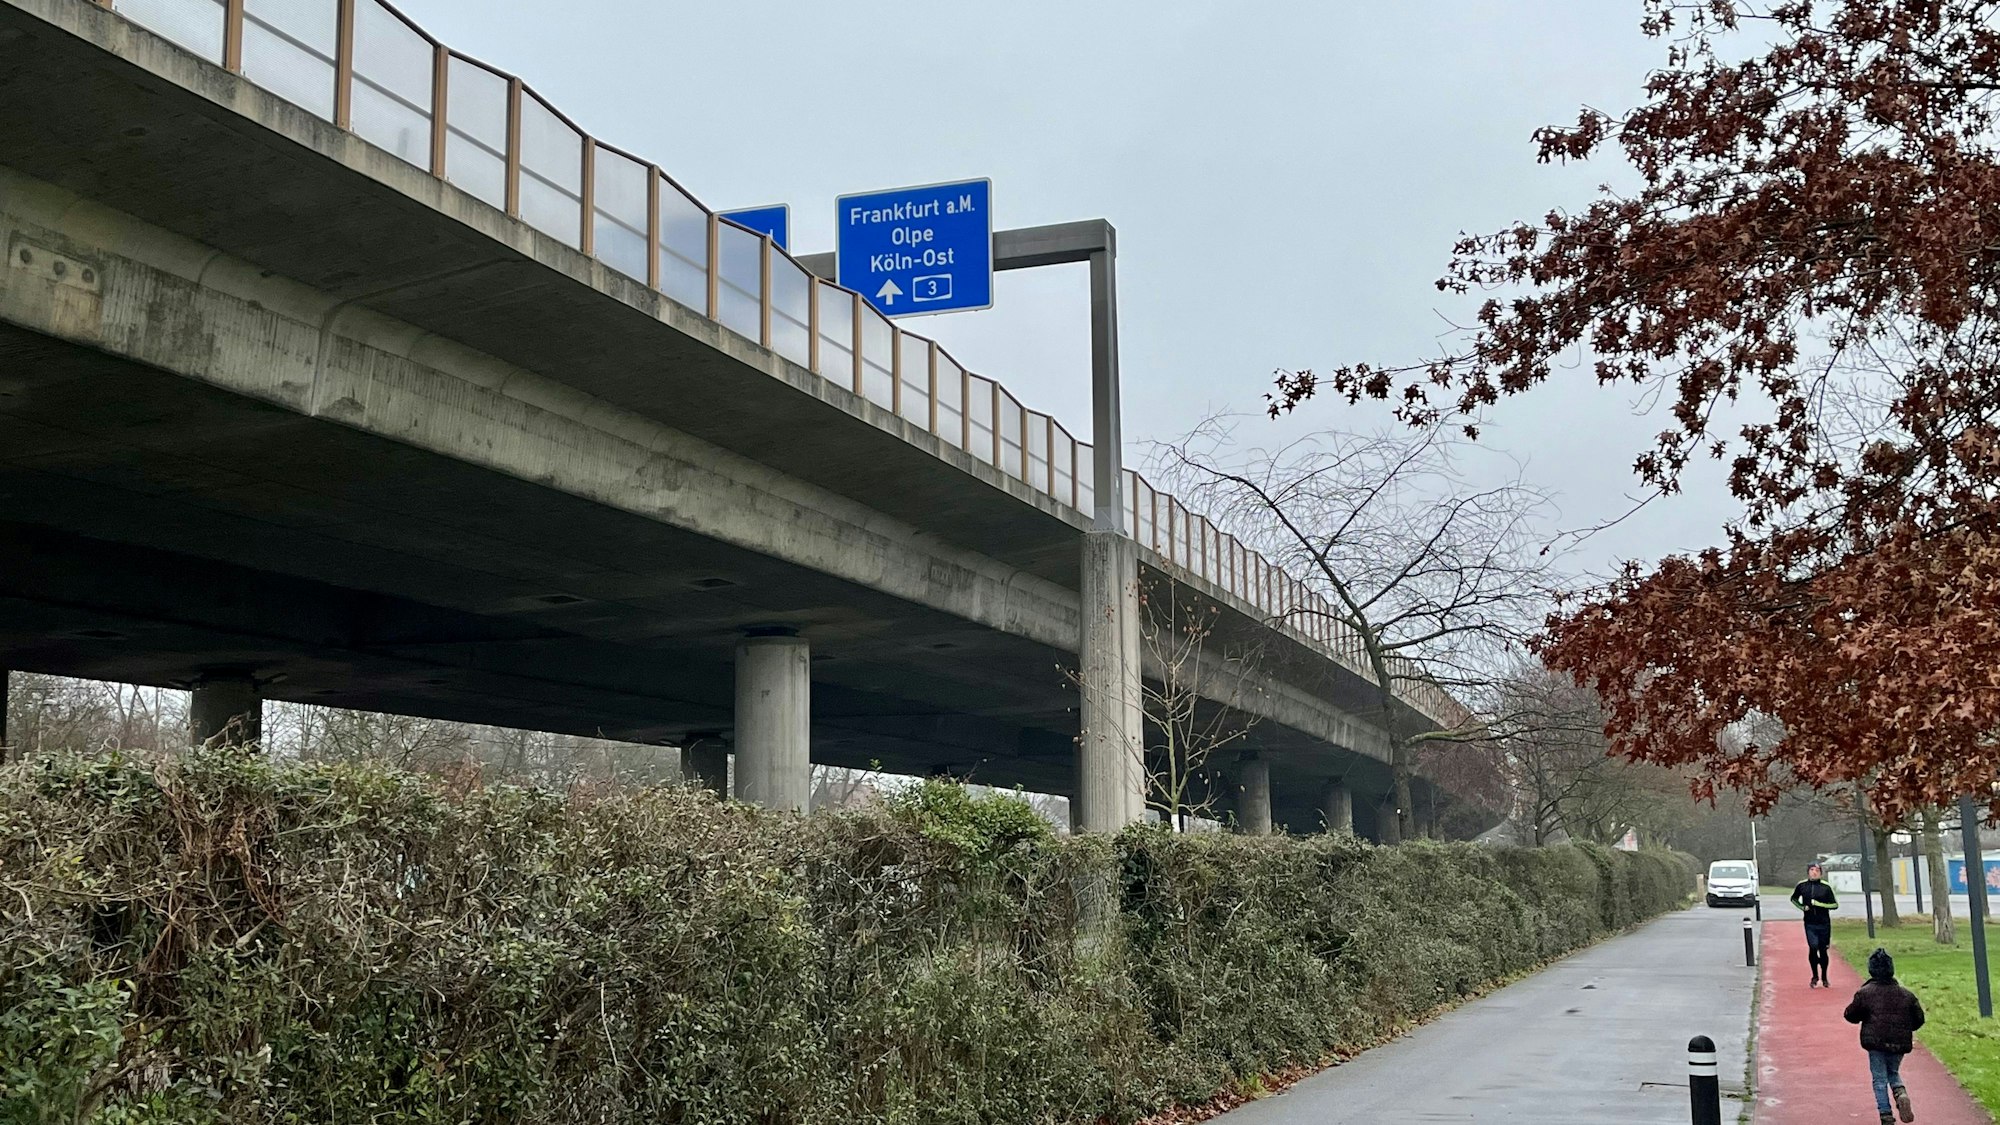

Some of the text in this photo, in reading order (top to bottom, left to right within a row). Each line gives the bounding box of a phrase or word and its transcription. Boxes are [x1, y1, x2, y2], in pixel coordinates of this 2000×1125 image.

[850, 194, 976, 226] Frankfurt a.M.
[891, 226, 934, 248] Olpe
[870, 247, 955, 273] Köln-Ost
[927, 280, 938, 296] 3
